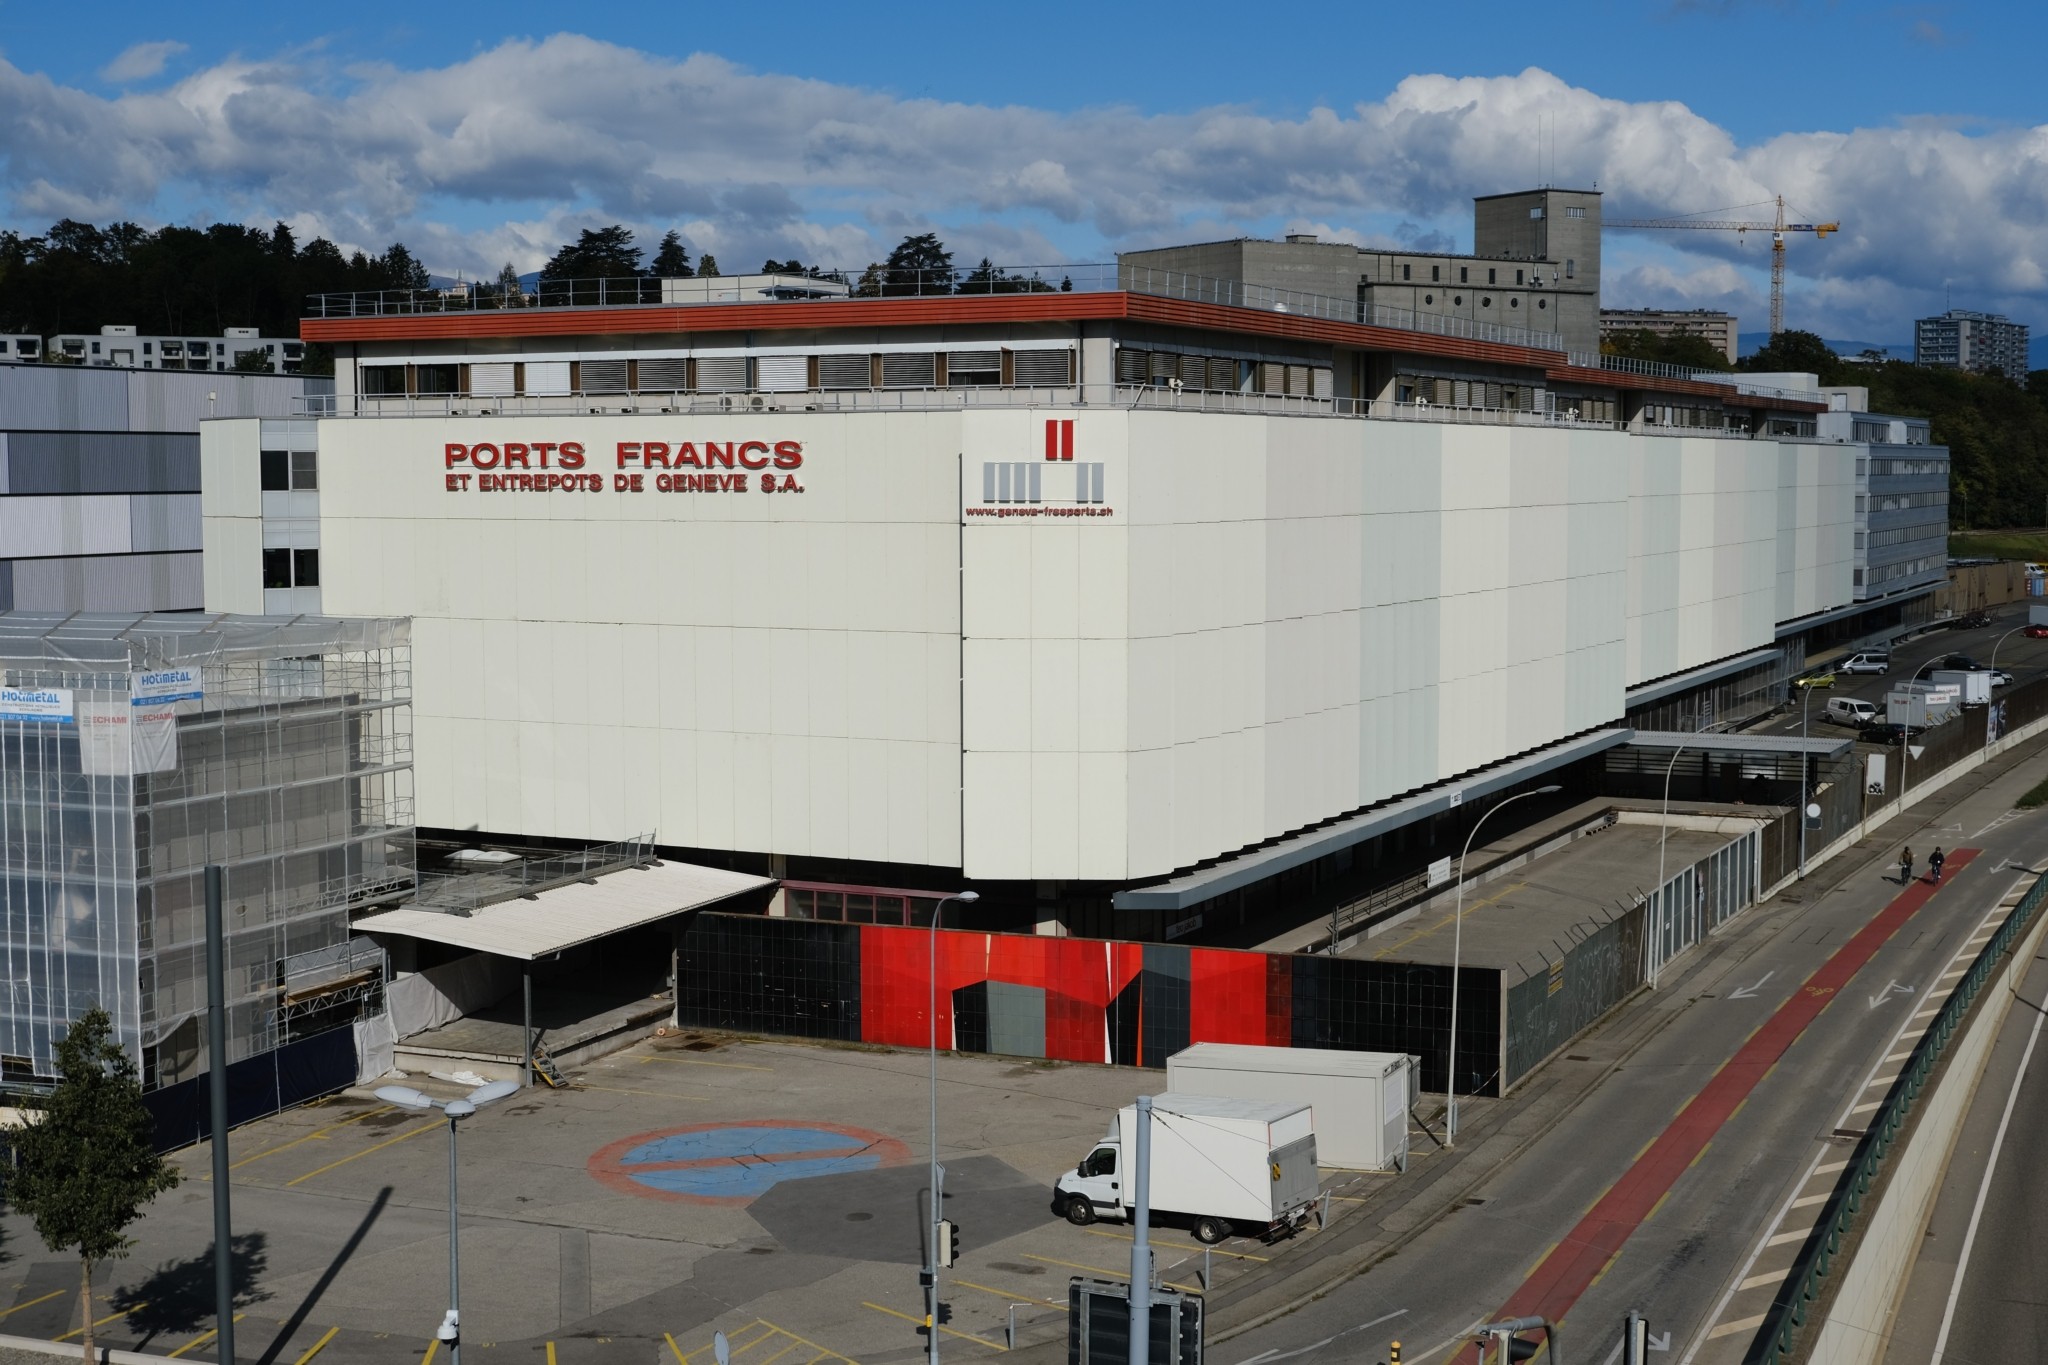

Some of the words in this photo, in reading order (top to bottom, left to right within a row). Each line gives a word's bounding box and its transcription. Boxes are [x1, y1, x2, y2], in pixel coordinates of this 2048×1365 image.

[445, 442, 585, 470] PORTS
[616, 441, 804, 470] FRANCS
[446, 474, 472, 492] ET
[479, 474, 604, 492] ENTREPOTS
[614, 474, 644, 492] DE
[656, 474, 748, 493] GENEVE
[761, 474, 805, 493] S.A.
[965, 507, 1114, 518] www.geneva-freeports.ch
